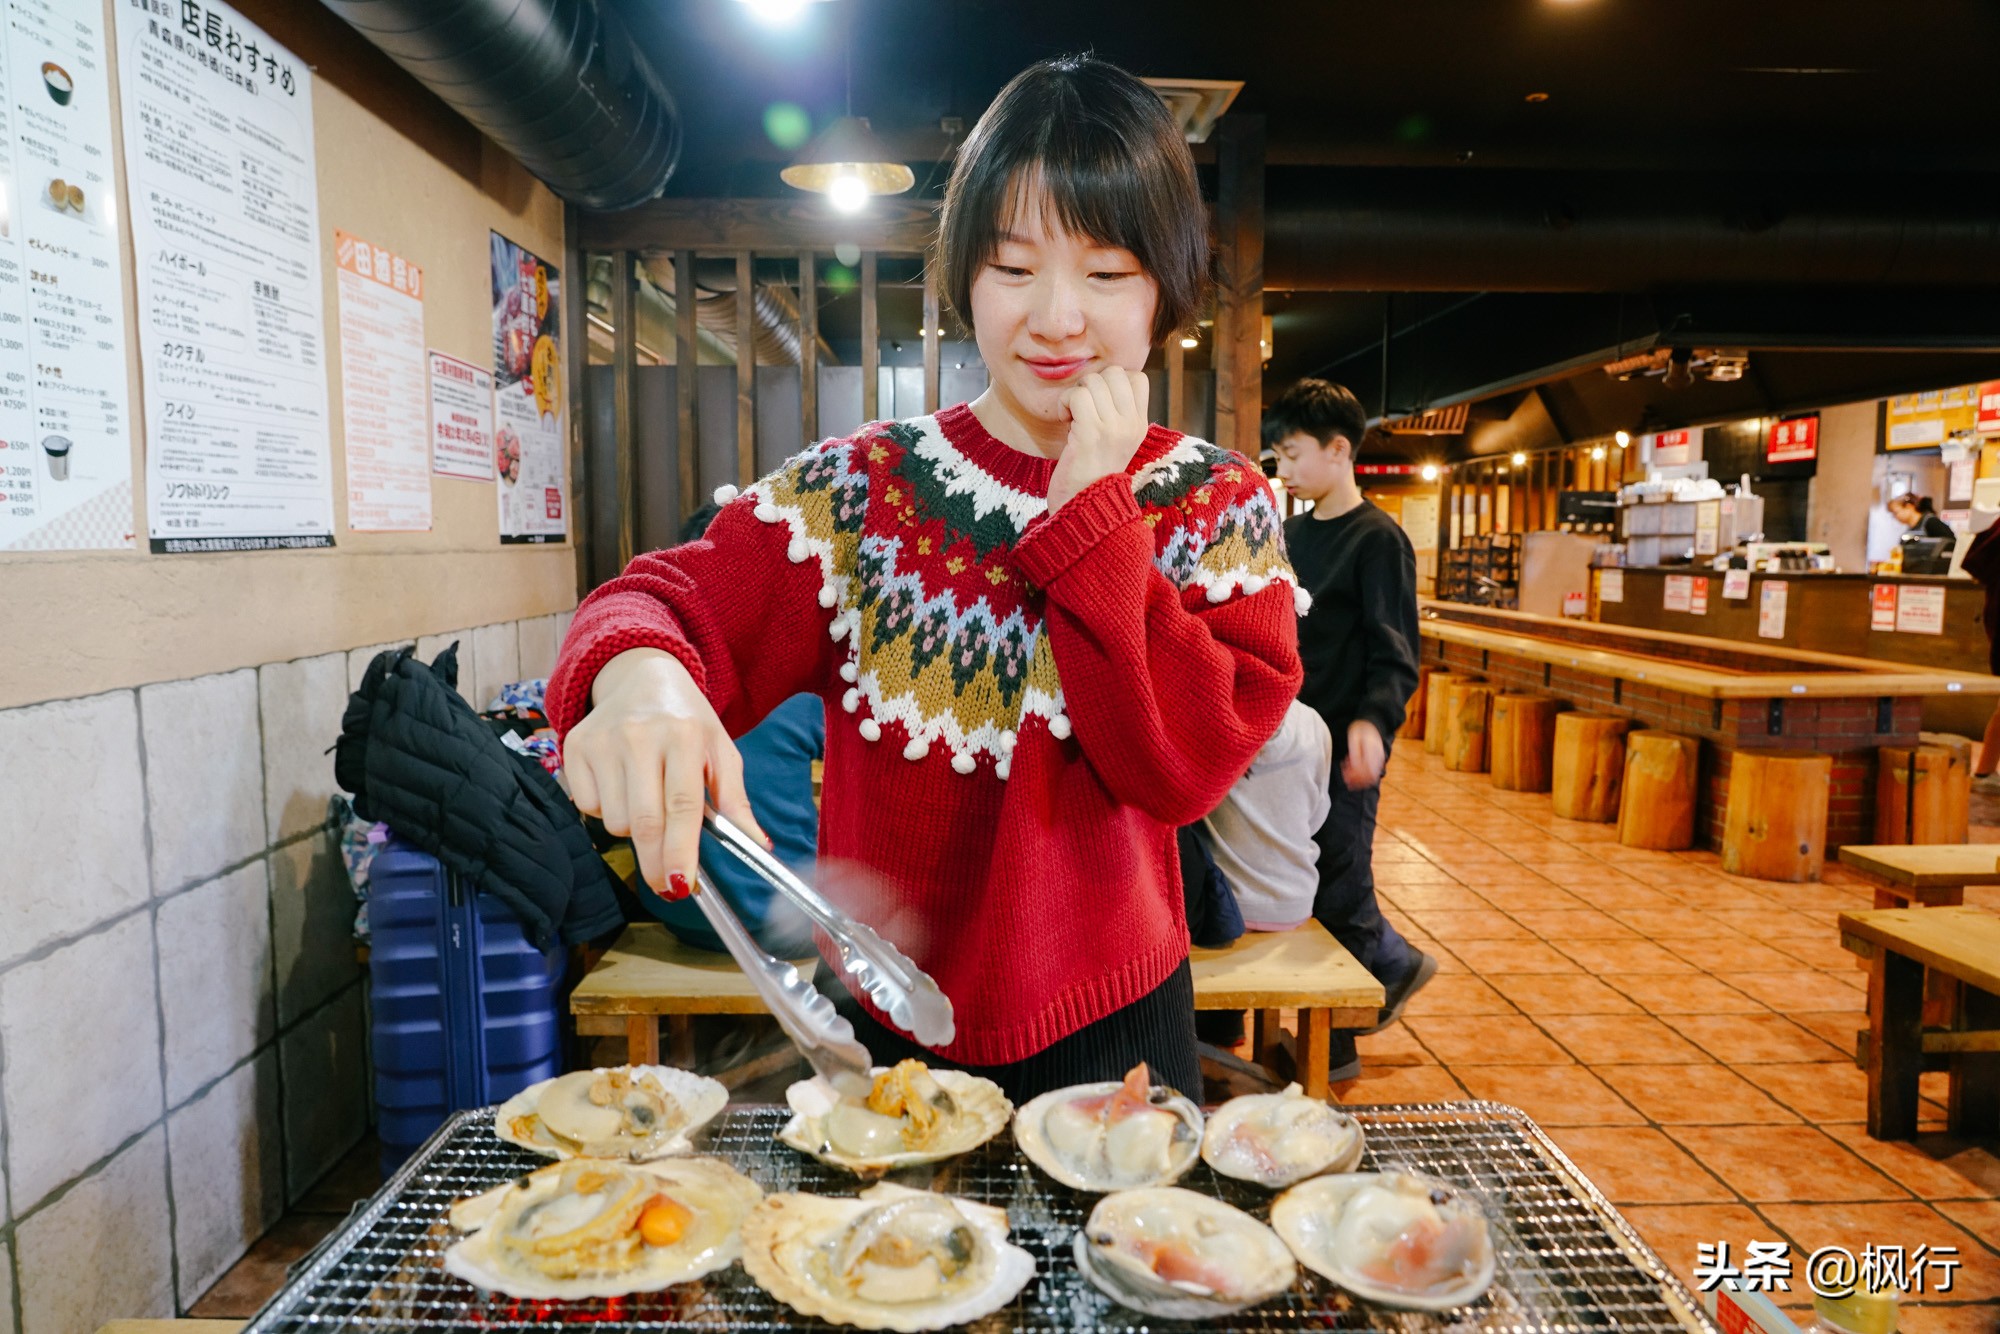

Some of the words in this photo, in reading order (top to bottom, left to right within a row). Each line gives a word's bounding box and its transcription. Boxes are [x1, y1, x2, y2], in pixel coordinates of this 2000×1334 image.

[181, 0, 296, 96] 店長おすすめ
[159, 250, 207, 277] ハイボール
[163, 342, 205, 363] カクテル
[165, 402, 195, 420] ワイン
[10, 440, 29, 450] 650円
[166, 482, 230, 500] ソフトドリンク
